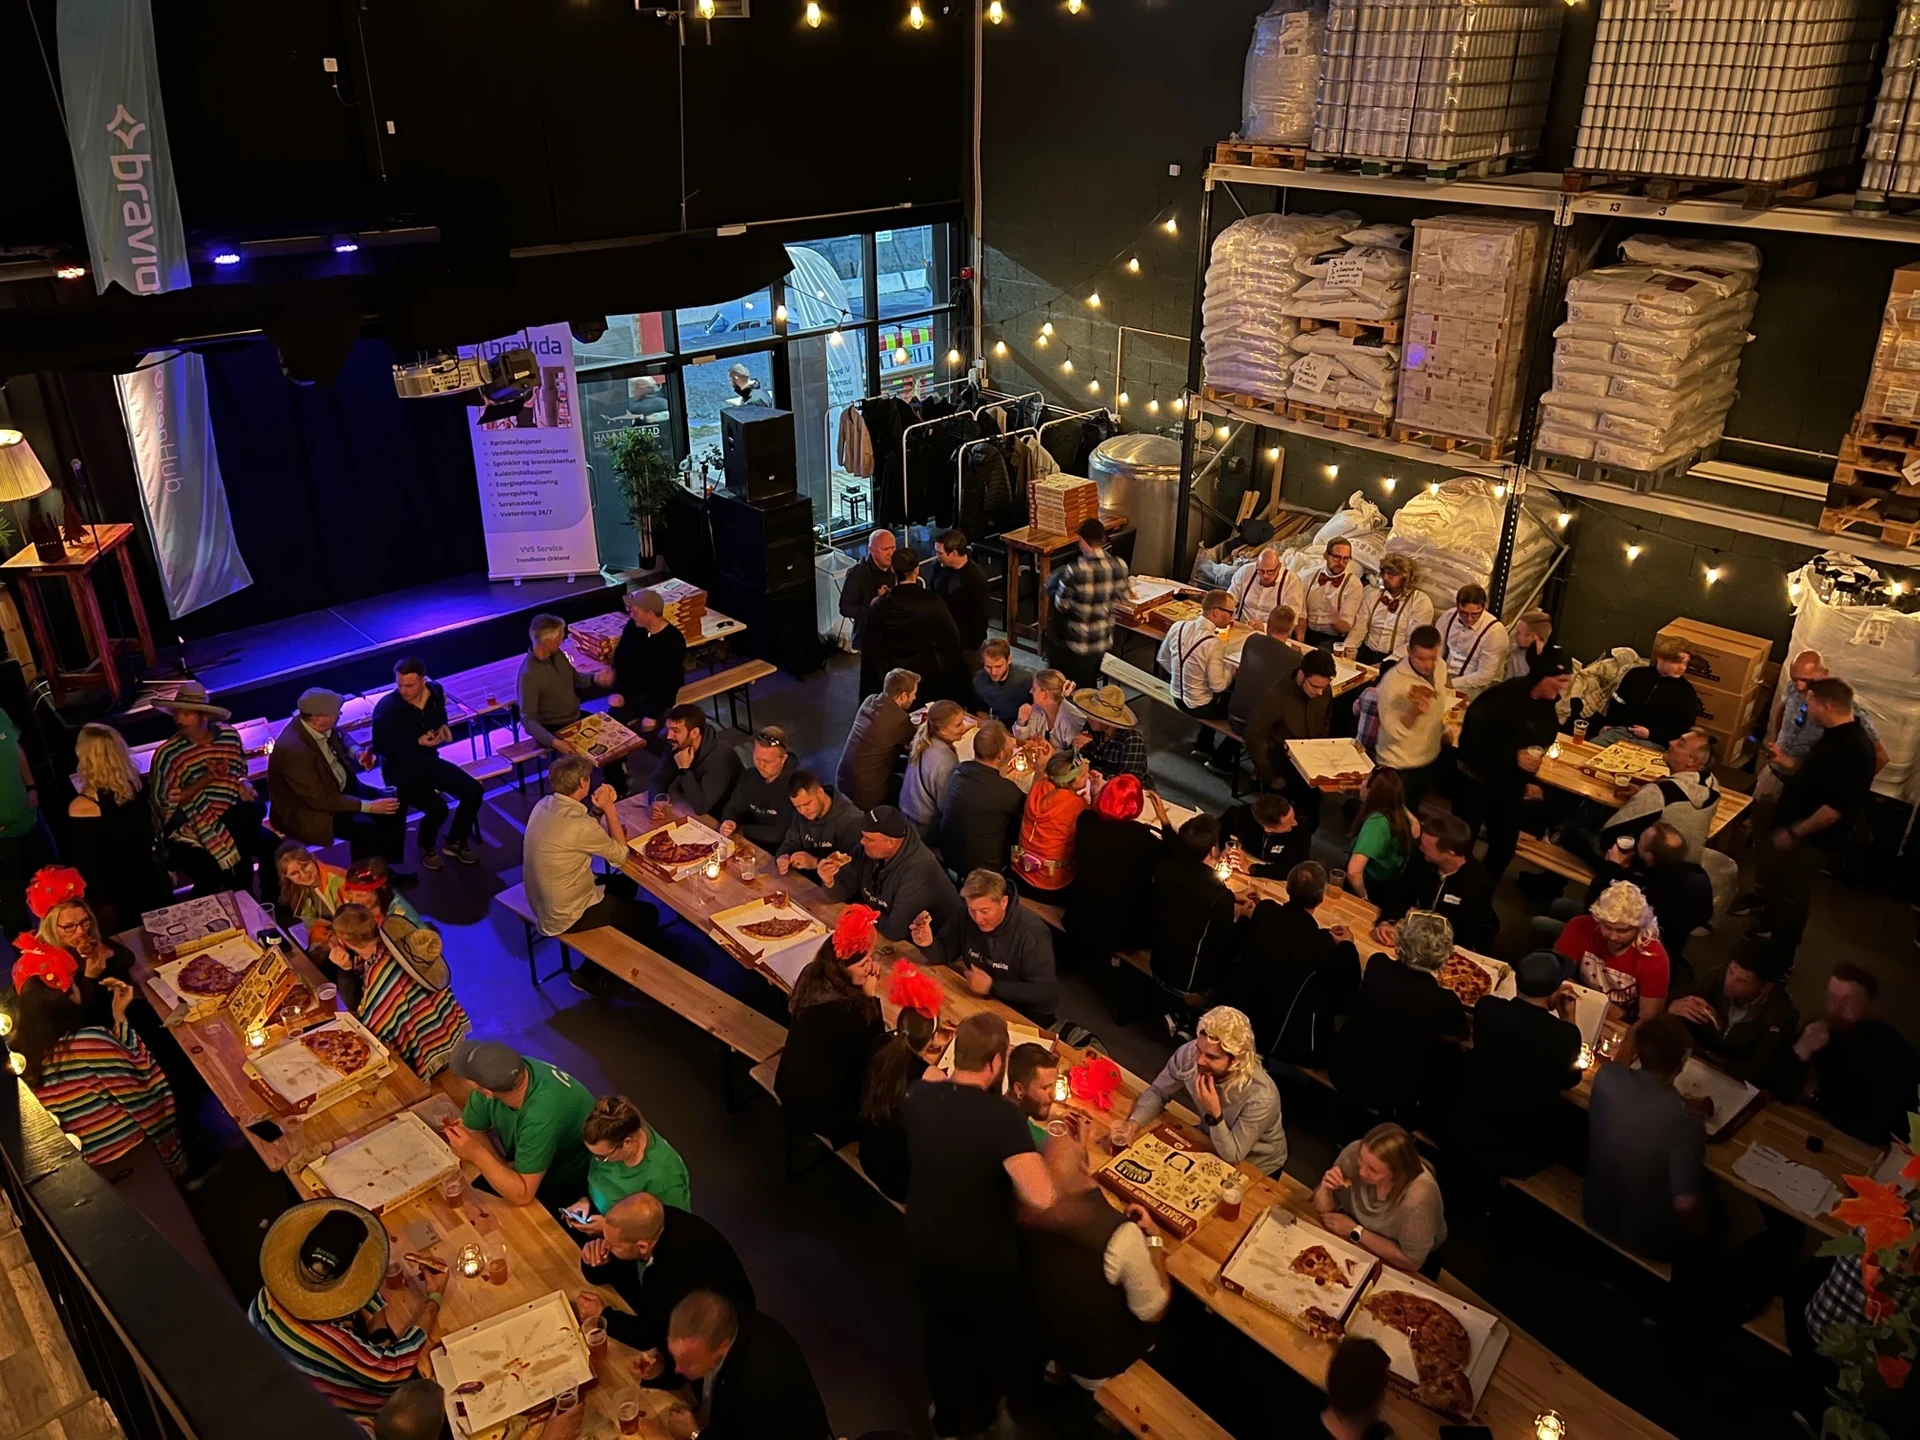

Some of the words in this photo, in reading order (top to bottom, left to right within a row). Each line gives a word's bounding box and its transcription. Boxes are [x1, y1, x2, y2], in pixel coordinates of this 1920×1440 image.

[1609, 202, 1621, 212] 13
[1658, 206, 1667, 216] 3
[110, 154, 161, 293] bravid
[154, 370, 184, 492] GreenHub
[491, 448, 569, 456] Ventilasjonsinstallasjoner
[493, 459, 521, 467] Sprinkler
[494, 469, 552, 477] Kuldeinstallasjoner
[496, 479, 558, 487] Energioptimalisering
[520, 545, 535, 553] VVS
[1133, 1189, 1159, 1209] BUNNER
[1157, 1204, 1192, 1227] NYBAKTE
